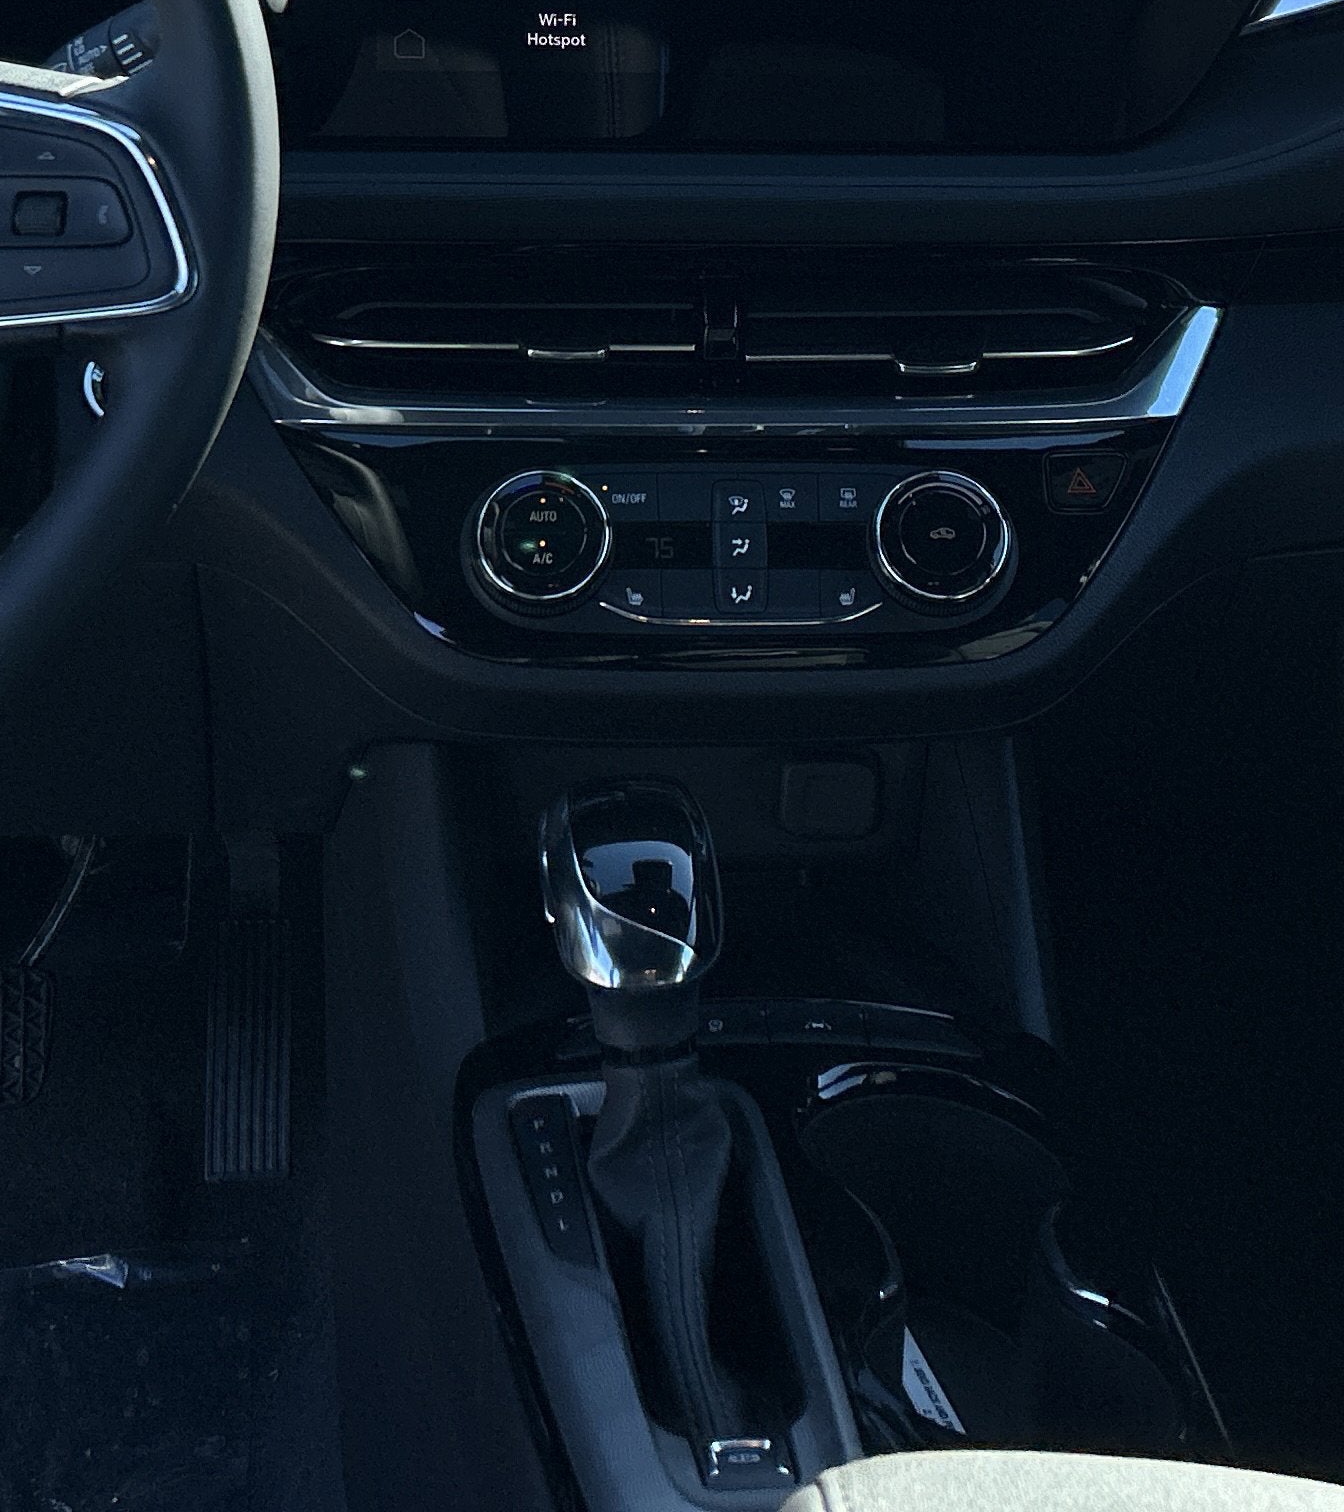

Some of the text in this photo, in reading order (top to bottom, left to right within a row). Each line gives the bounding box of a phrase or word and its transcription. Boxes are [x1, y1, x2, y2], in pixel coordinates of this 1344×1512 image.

[538, 13, 577, 28] Wi-Fi
[526, 32, 587, 50] Hotspot
[611, 492, 647, 505] ON/OFF
[529, 510, 557, 523] AUTO
[646, 536, 674, 559] 75
[532, 552, 554, 566] A/C
